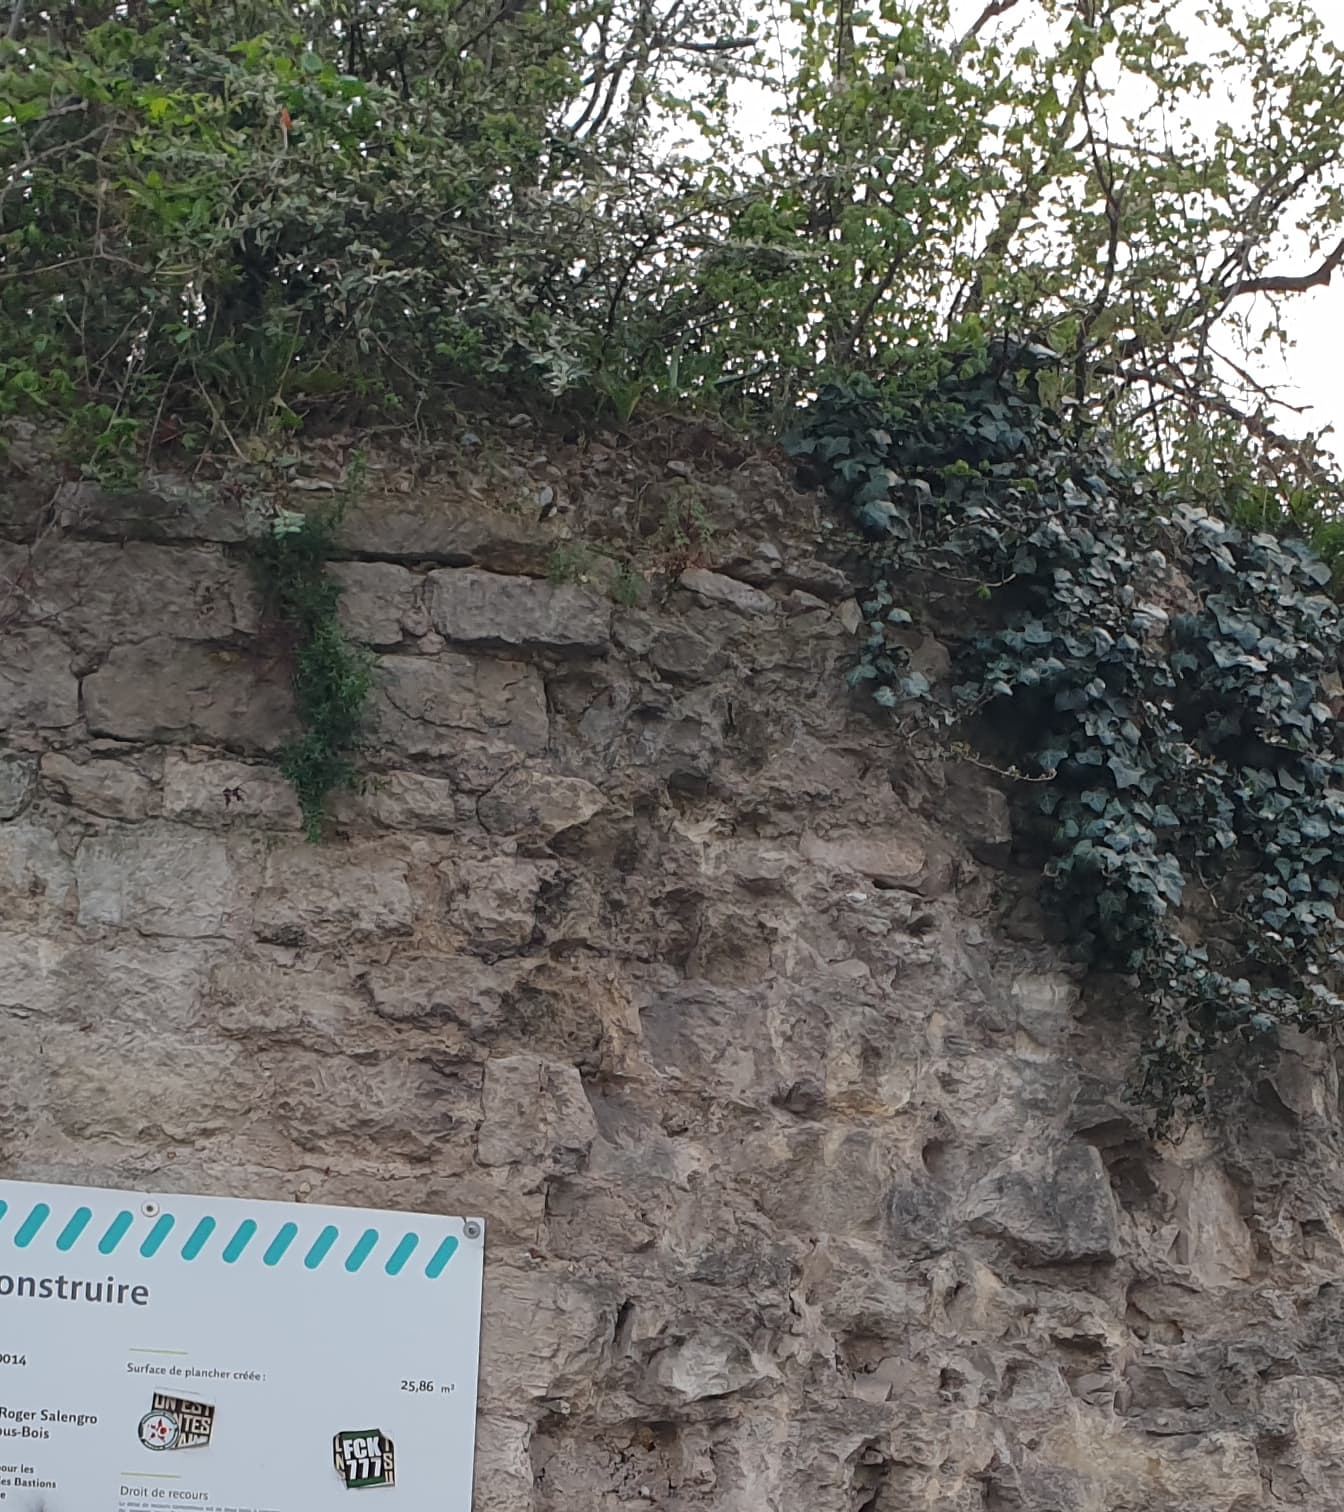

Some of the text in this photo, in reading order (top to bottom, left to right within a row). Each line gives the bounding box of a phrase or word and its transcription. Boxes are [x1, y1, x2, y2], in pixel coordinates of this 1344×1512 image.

[127, 1362, 167, 1376] Surface
[169, 1366, 182, 1376] de
[185, 1367, 230, 1379] plancher
[400, 1380, 434, 1392] 25,86
[40, 1409, 98, 1426] Salengro
[343, 1436, 382, 1460] FCK
[20, 1463, 35, 1474] les
[346, 1457, 382, 1480] 777
[14, 1477, 57, 1489] Bastions
[120, 1485, 209, 1501] Droit de recours
